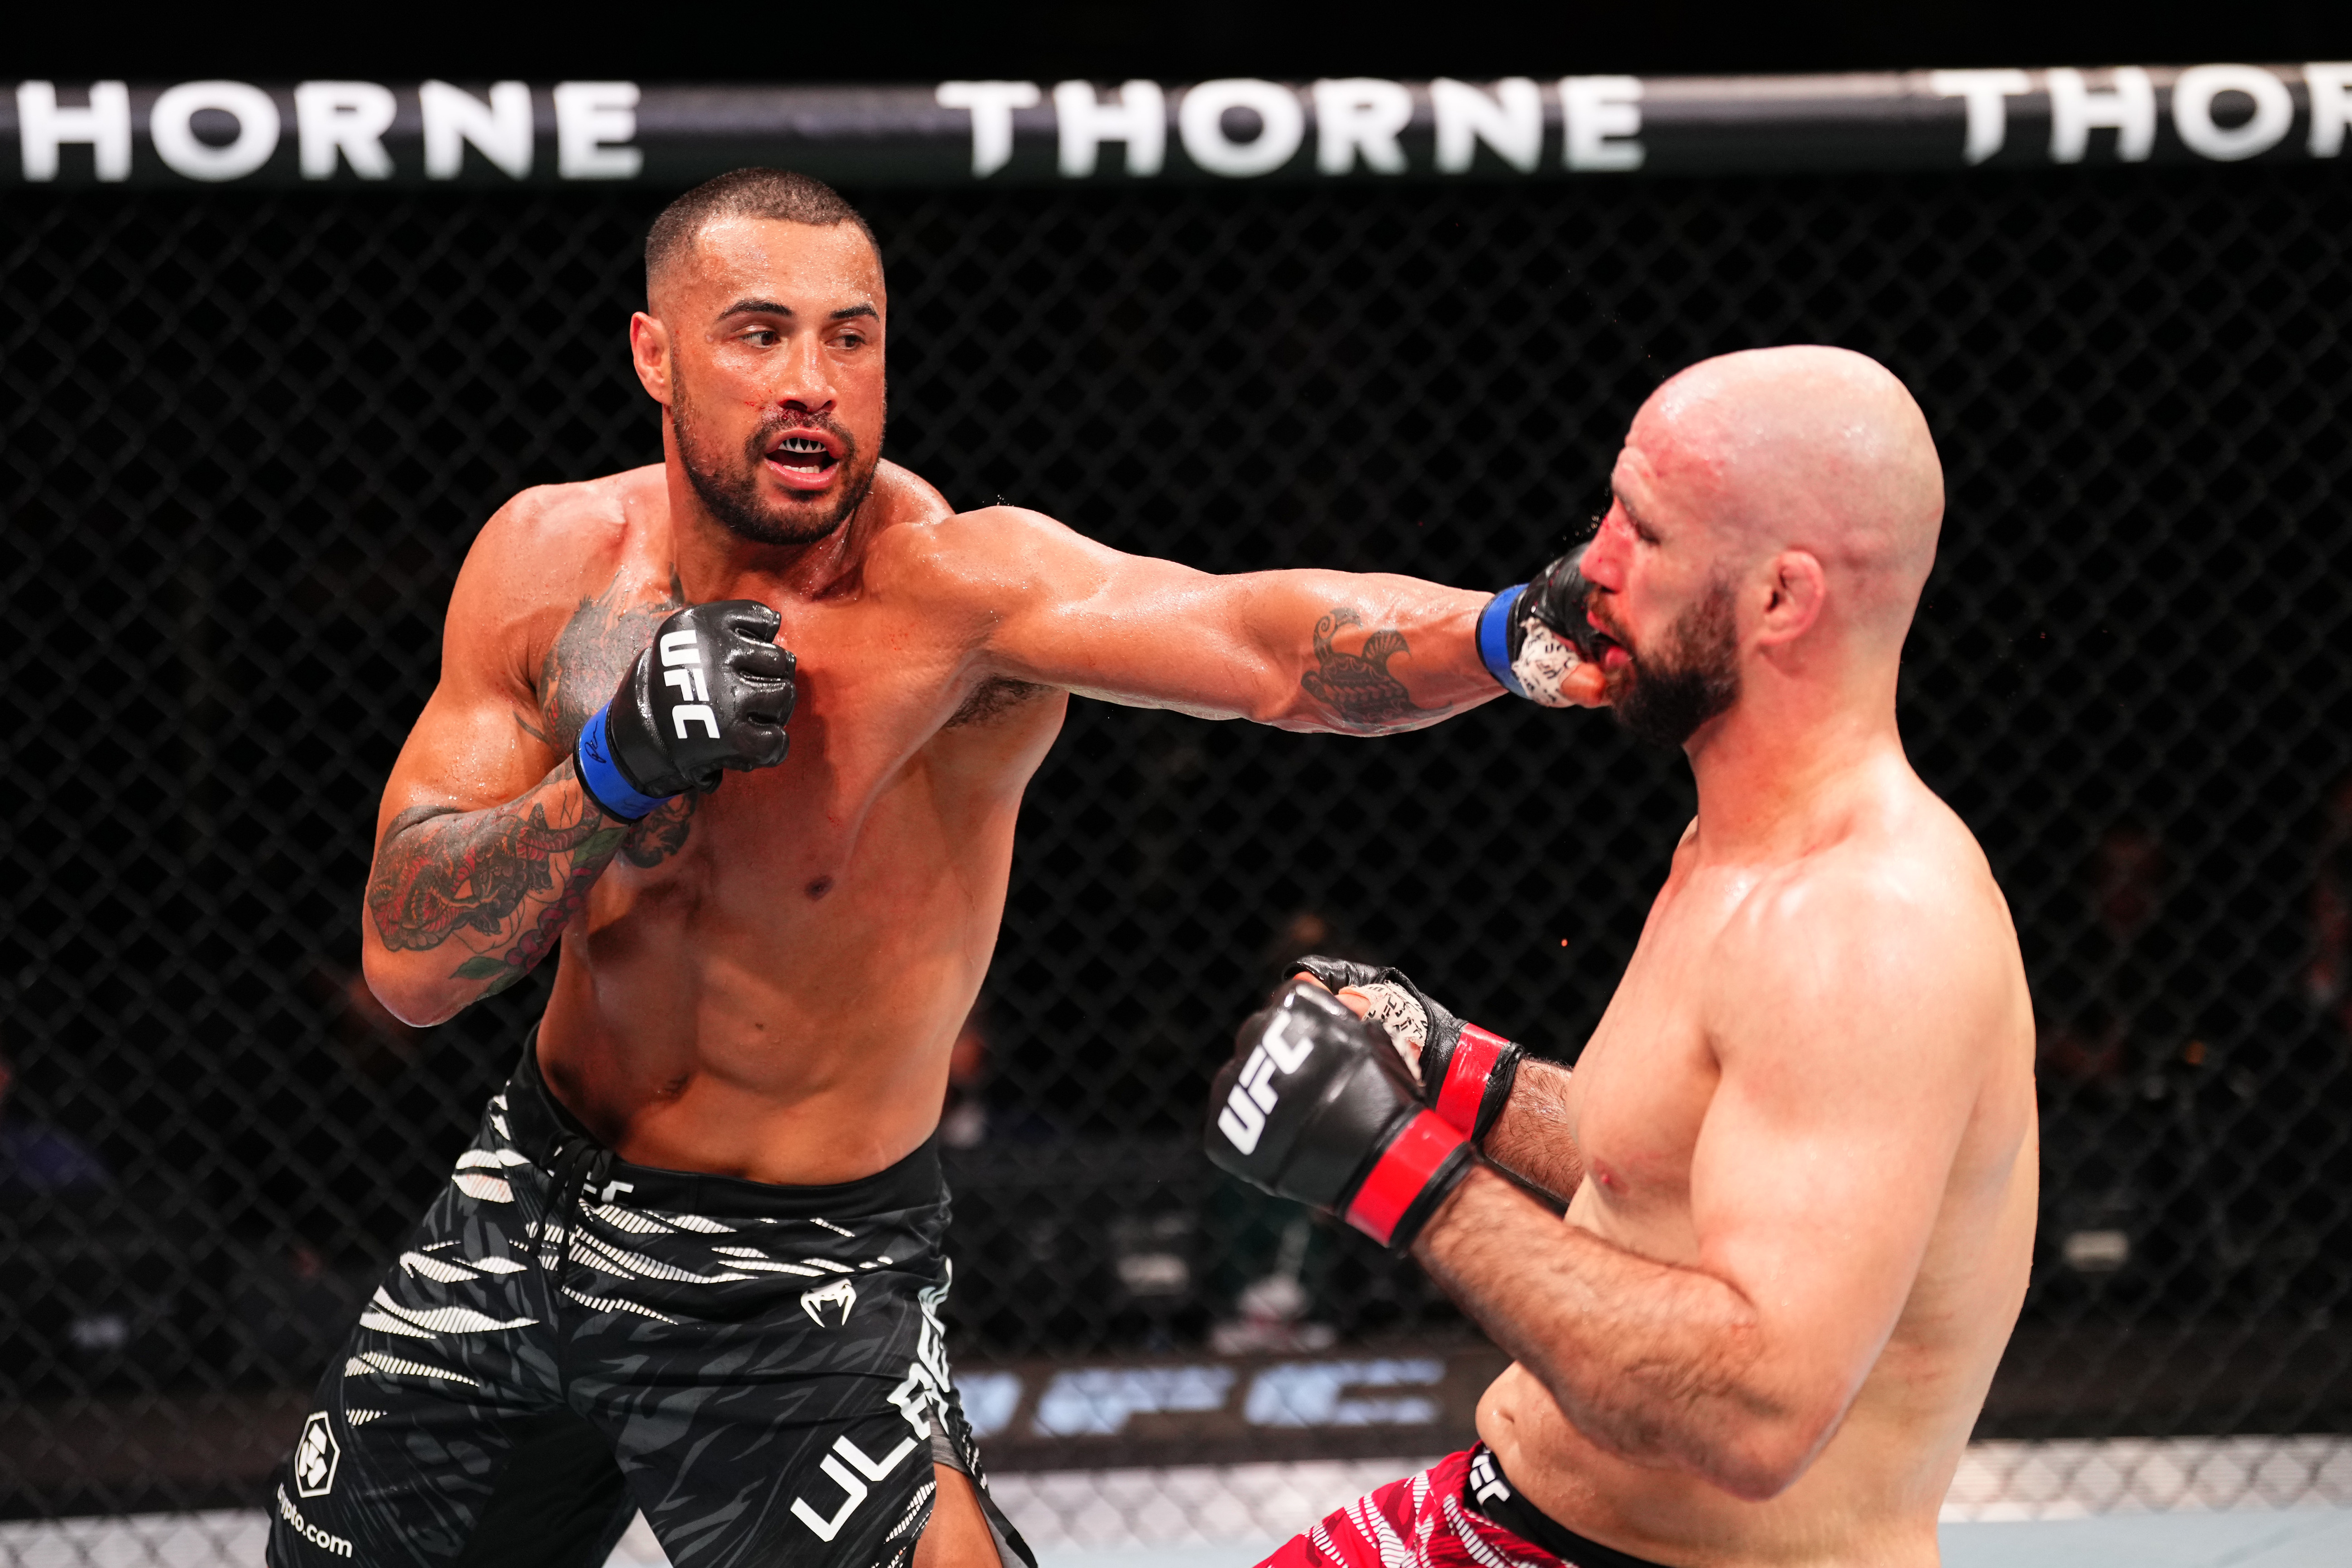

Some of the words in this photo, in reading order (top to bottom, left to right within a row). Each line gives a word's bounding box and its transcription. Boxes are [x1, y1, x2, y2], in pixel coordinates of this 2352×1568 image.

[934, 75, 1645, 177] THORNE
[660, 630, 721, 739] UFC
[1217, 1010, 1314, 1155] UFC
